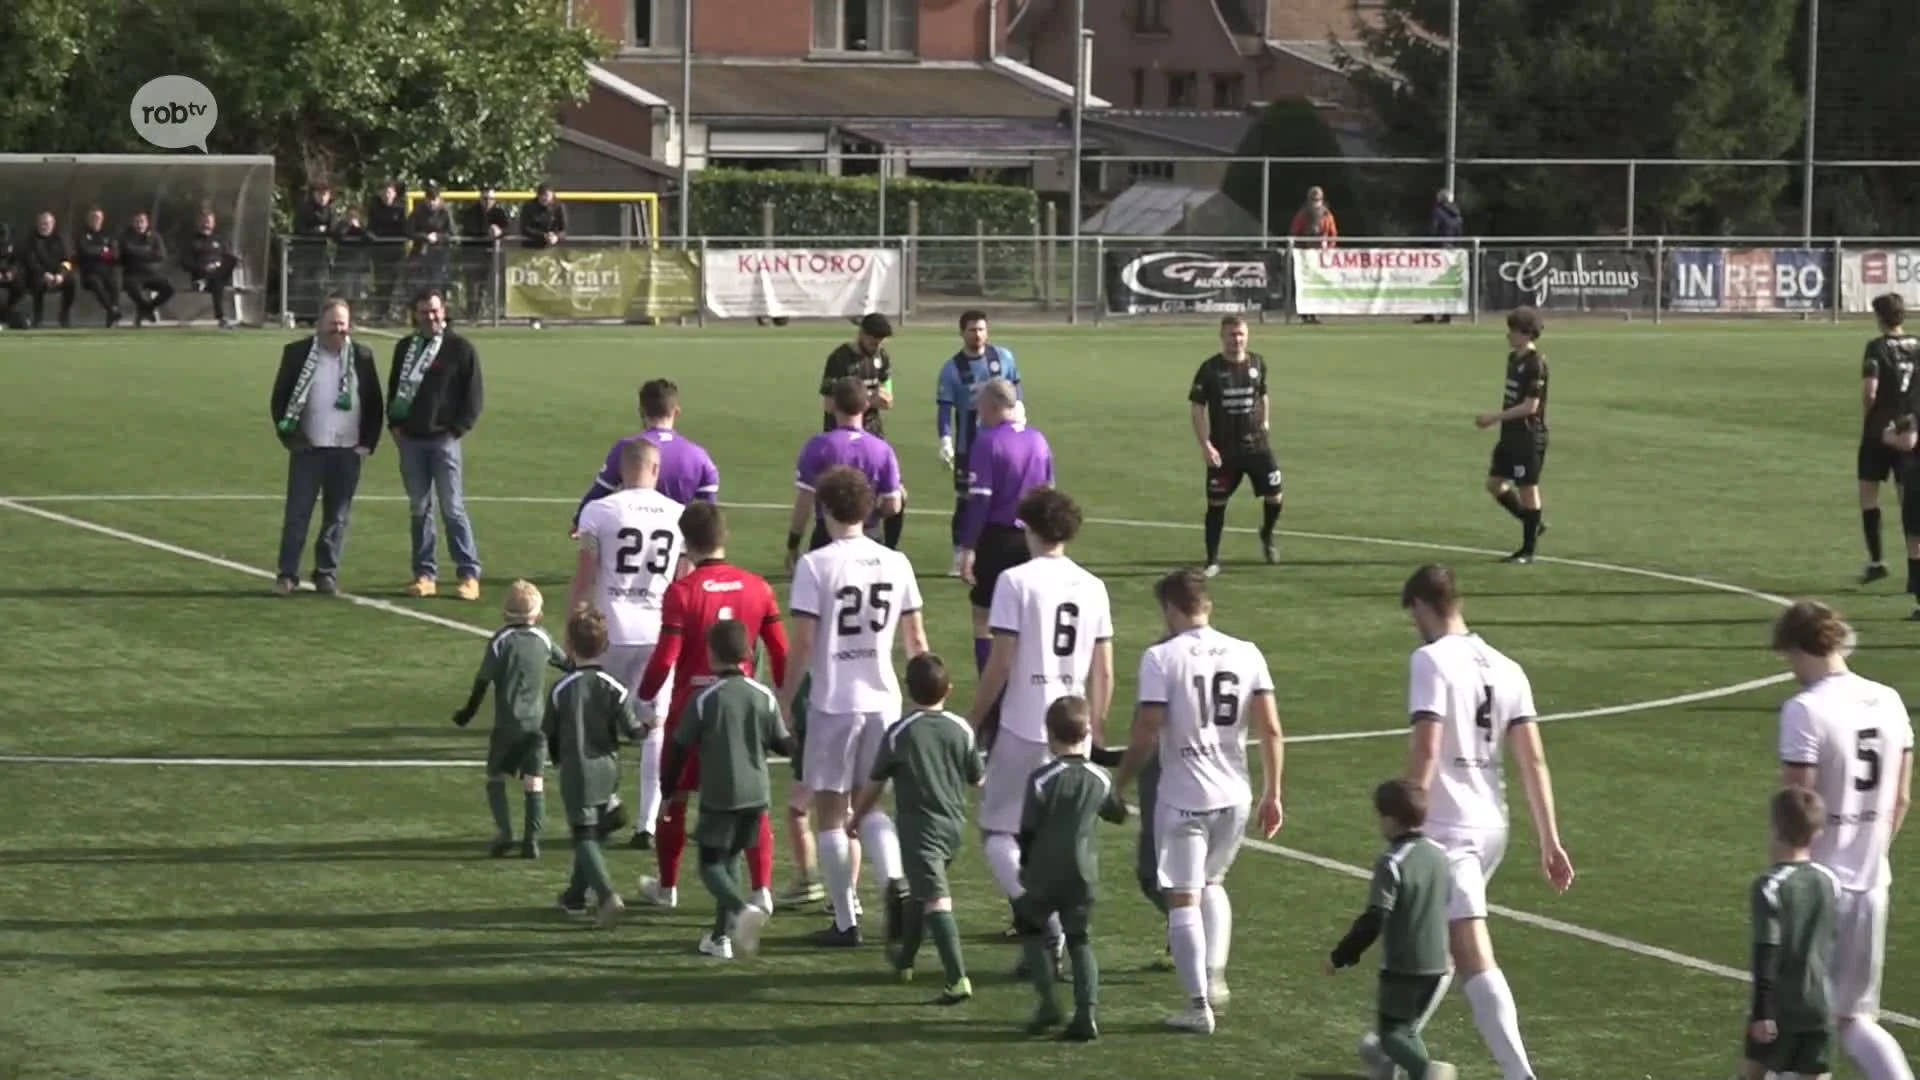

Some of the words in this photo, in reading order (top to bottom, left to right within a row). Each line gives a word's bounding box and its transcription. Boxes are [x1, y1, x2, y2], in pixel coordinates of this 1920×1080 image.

[507, 267, 539, 285] Da
[737, 254, 865, 273] KANTORO
[1162, 261, 1267, 281] GTA
[1318, 251, 1442, 268] LAMBRECHTS
[1498, 251, 1639, 307] Gambrinus
[1898, 362, 1914, 392] 7
[616, 527, 674, 573] 23
[835, 583, 893, 636] 25
[1053, 602, 1079, 656] 6
[1193, 671, 1240, 728] 16
[1476, 684, 1494, 743] 4
[1855, 727, 1880, 792] 5
